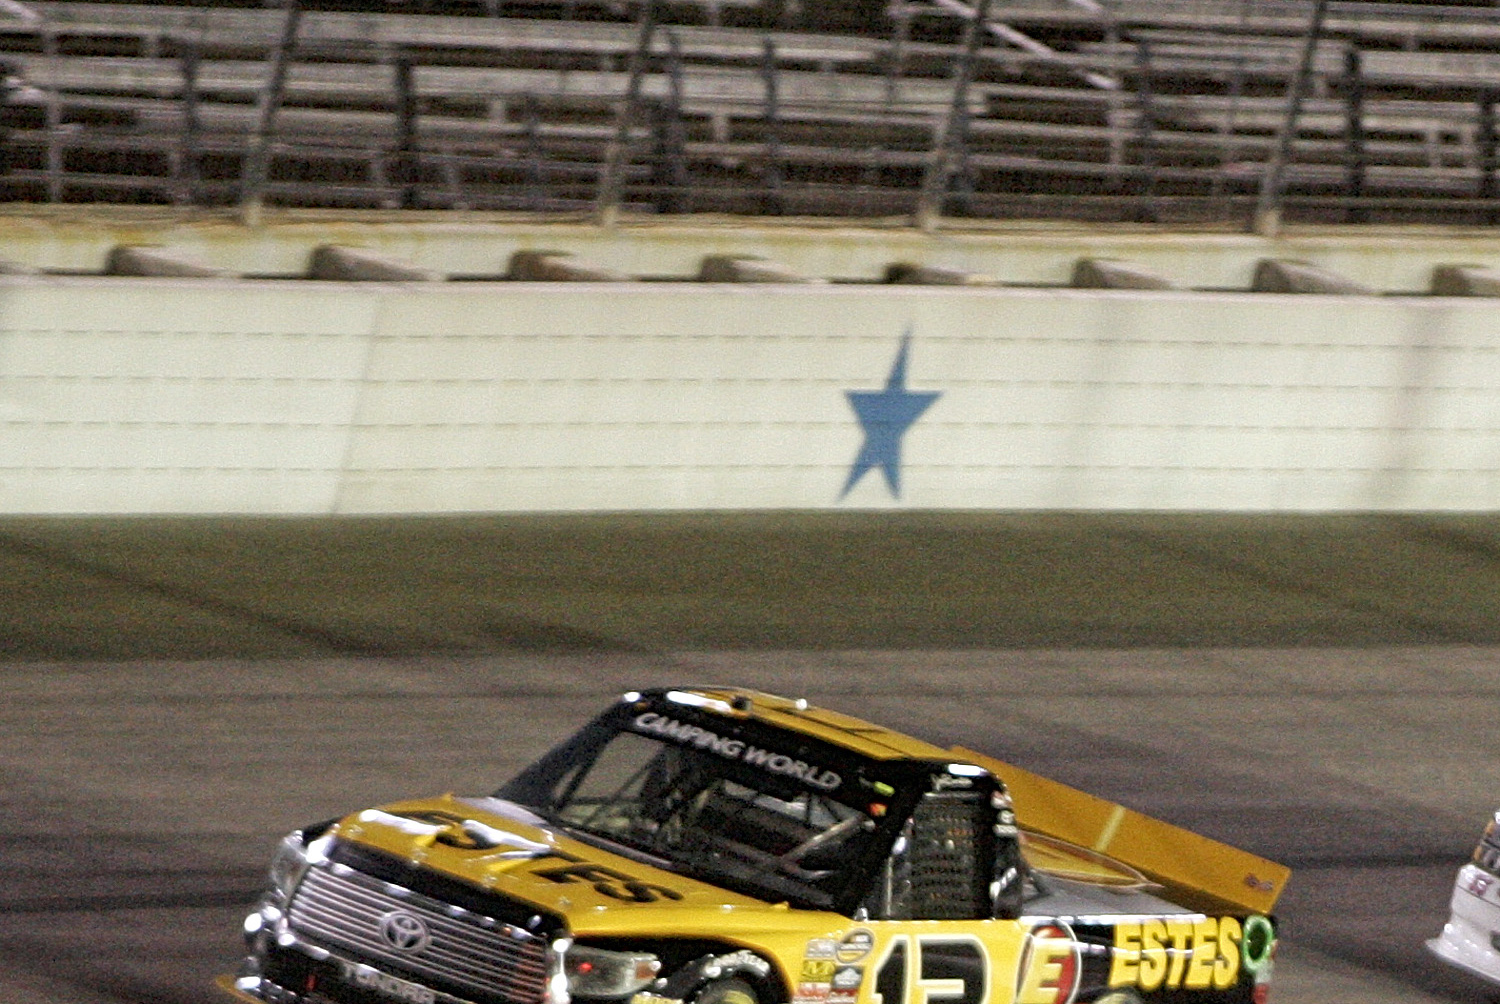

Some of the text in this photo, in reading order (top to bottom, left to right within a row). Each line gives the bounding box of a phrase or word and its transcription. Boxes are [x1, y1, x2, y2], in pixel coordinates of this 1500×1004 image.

[635, 712, 843, 791] CAMPING WORLD
[1108, 914, 1243, 991] ESTES
